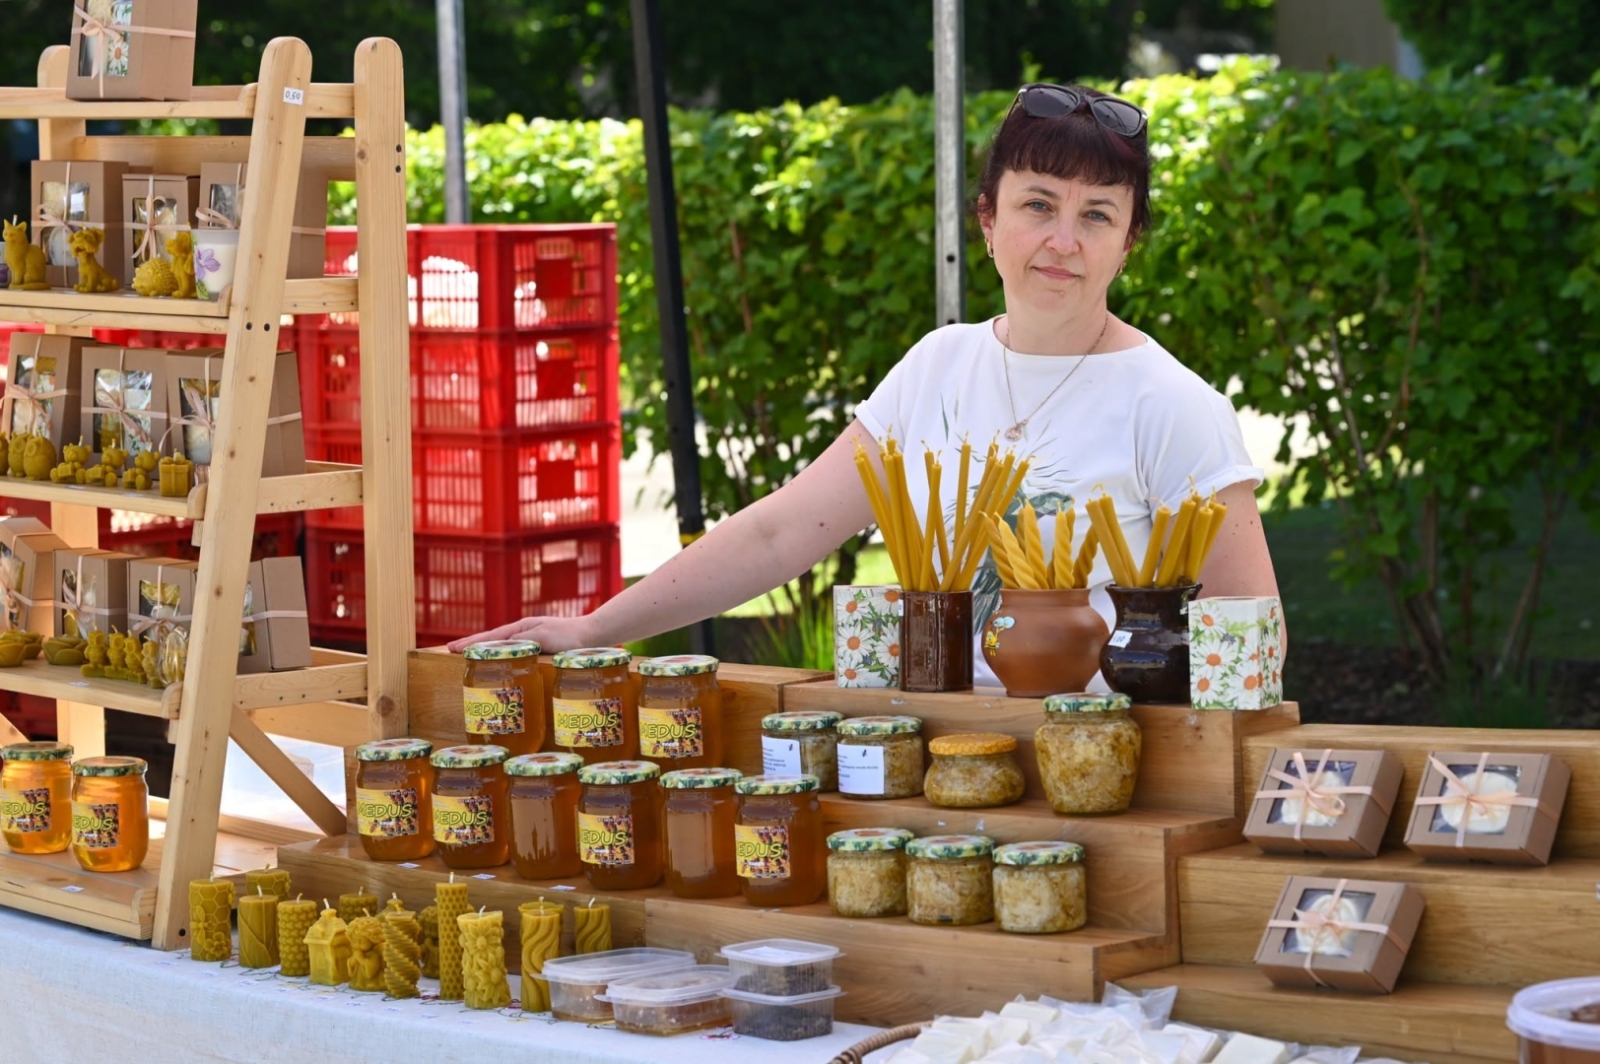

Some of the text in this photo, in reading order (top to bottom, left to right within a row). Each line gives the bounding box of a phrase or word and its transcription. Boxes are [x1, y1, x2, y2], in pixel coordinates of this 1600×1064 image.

[557, 710, 618, 729] MEDUS
[2, 801, 46, 816] EDUS
[74, 814, 115, 831] EDUS
